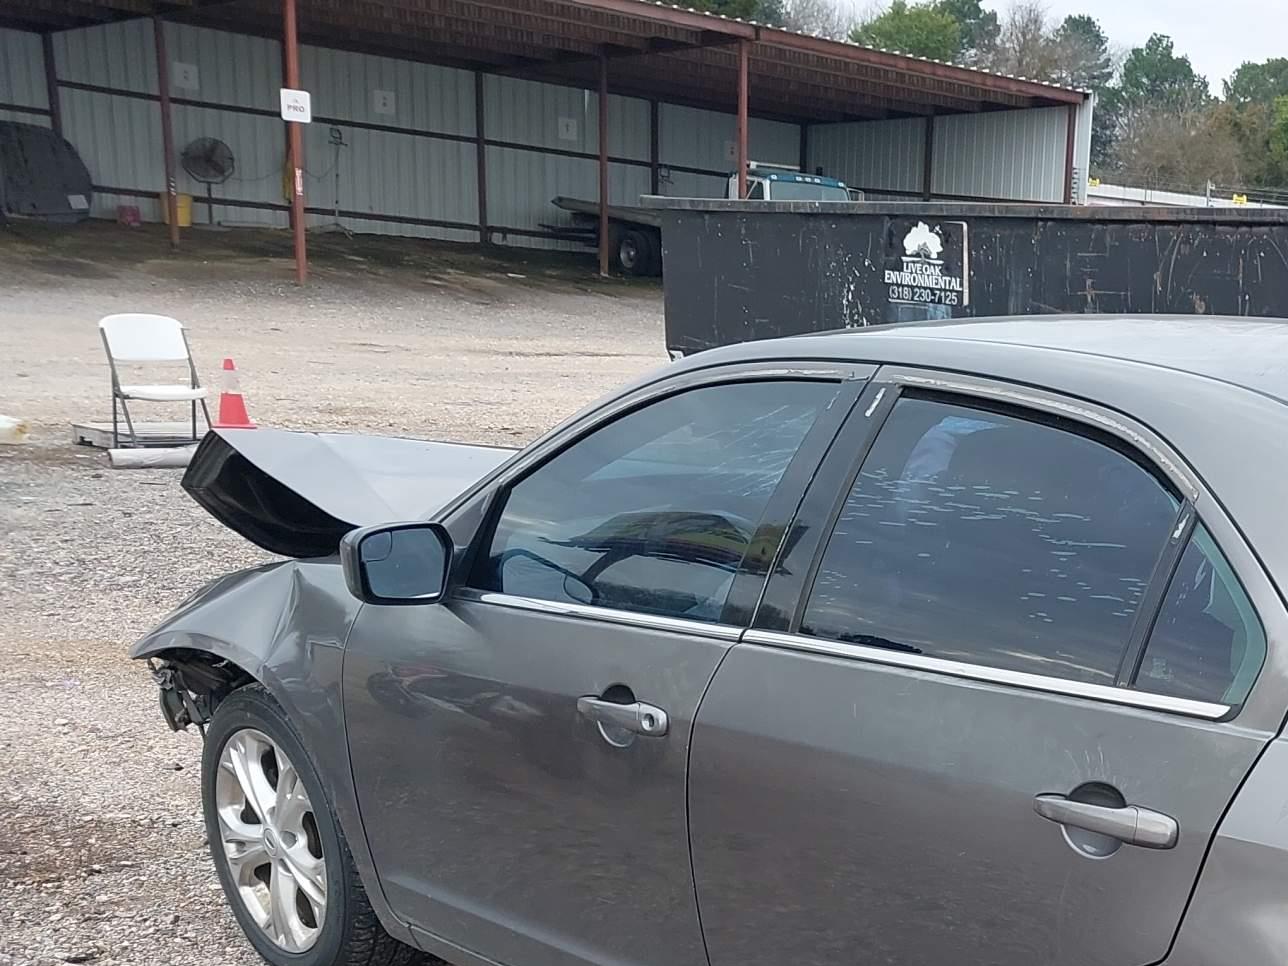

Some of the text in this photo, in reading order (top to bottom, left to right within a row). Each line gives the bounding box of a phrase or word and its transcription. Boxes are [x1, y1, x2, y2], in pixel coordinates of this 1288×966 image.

[903, 262, 942, 276] LIVE OAK
[884, 270, 963, 291] ENVIRONMENTAL
[889, 286, 958, 305] (318) 230-7125
